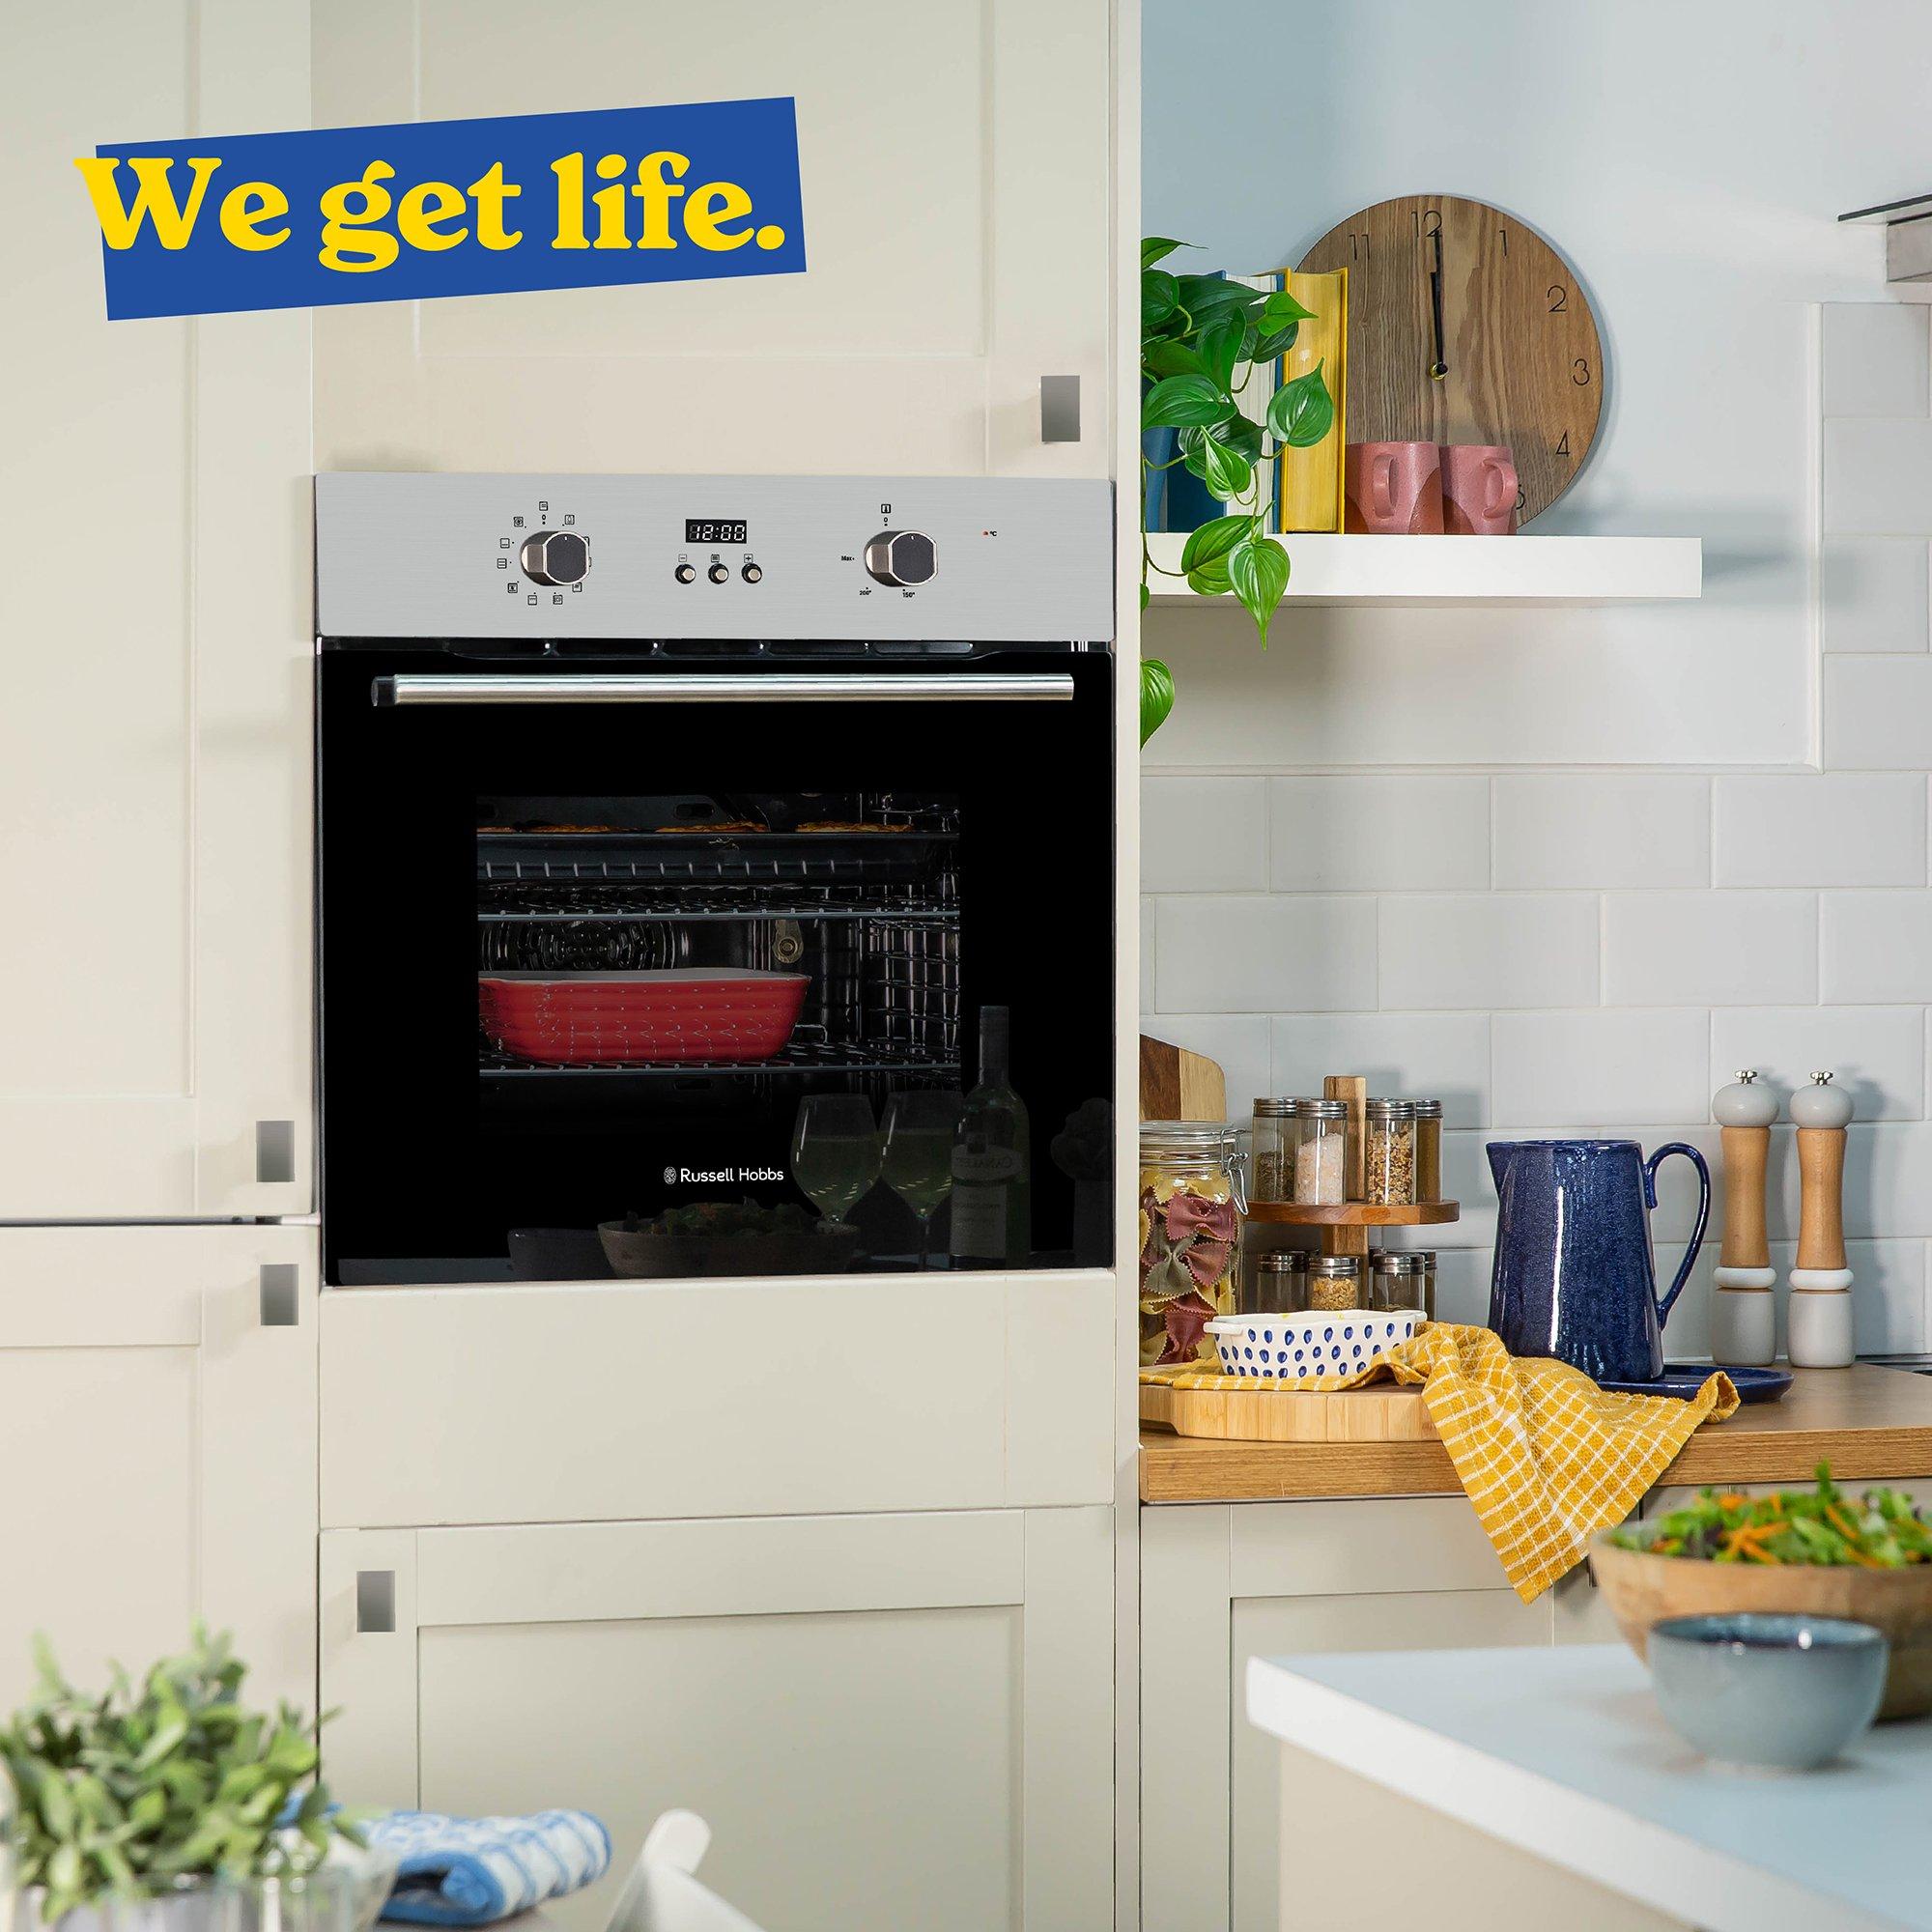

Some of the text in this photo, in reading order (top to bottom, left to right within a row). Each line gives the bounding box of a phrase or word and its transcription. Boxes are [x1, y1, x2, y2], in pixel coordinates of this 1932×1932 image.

[1411, 210, 1442, 238] 12
[1350, 234, 1370, 260] 11
[1498, 230, 1508, 257] 1
[1547, 285, 1568, 313] 2
[1573, 358, 1591, 386] 3
[1555, 431, 1571, 458] 4
[694, 525, 746, 541] 12:00
[680, 1167, 784, 1182] Russell Hobbs
